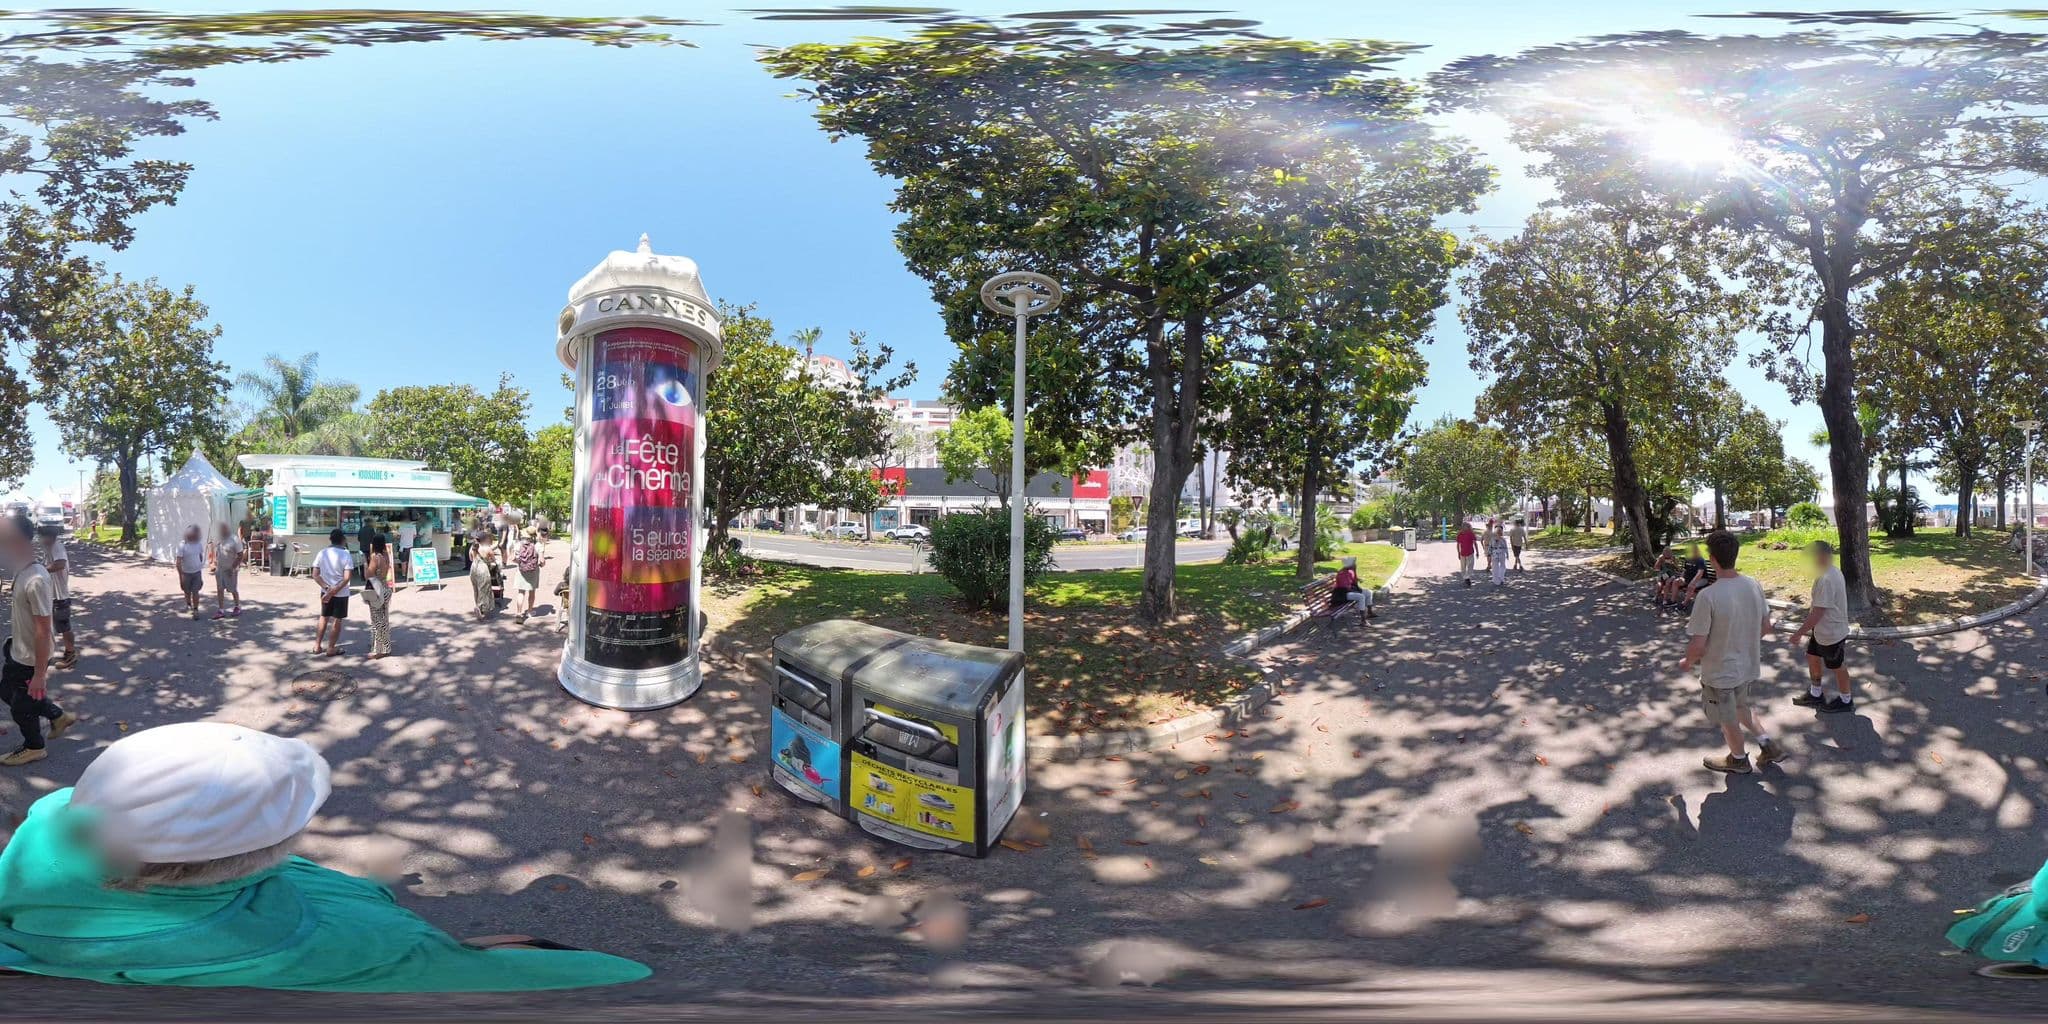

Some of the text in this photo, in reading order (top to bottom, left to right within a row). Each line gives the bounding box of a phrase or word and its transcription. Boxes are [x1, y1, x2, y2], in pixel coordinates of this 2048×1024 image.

[598, 295, 706, 326] CANNES
[597, 375, 616, 389] 28
[609, 401, 633, 409] Juillet
[611, 433, 679, 465] La Fête
[358, 469, 382, 480] KIOSQUE
[608, 461, 690, 492] Cinéma
[632, 528, 688, 547] 5 euros
[632, 545, 688, 561] la séance
[897, 772, 958, 793] RECYCLABLES
